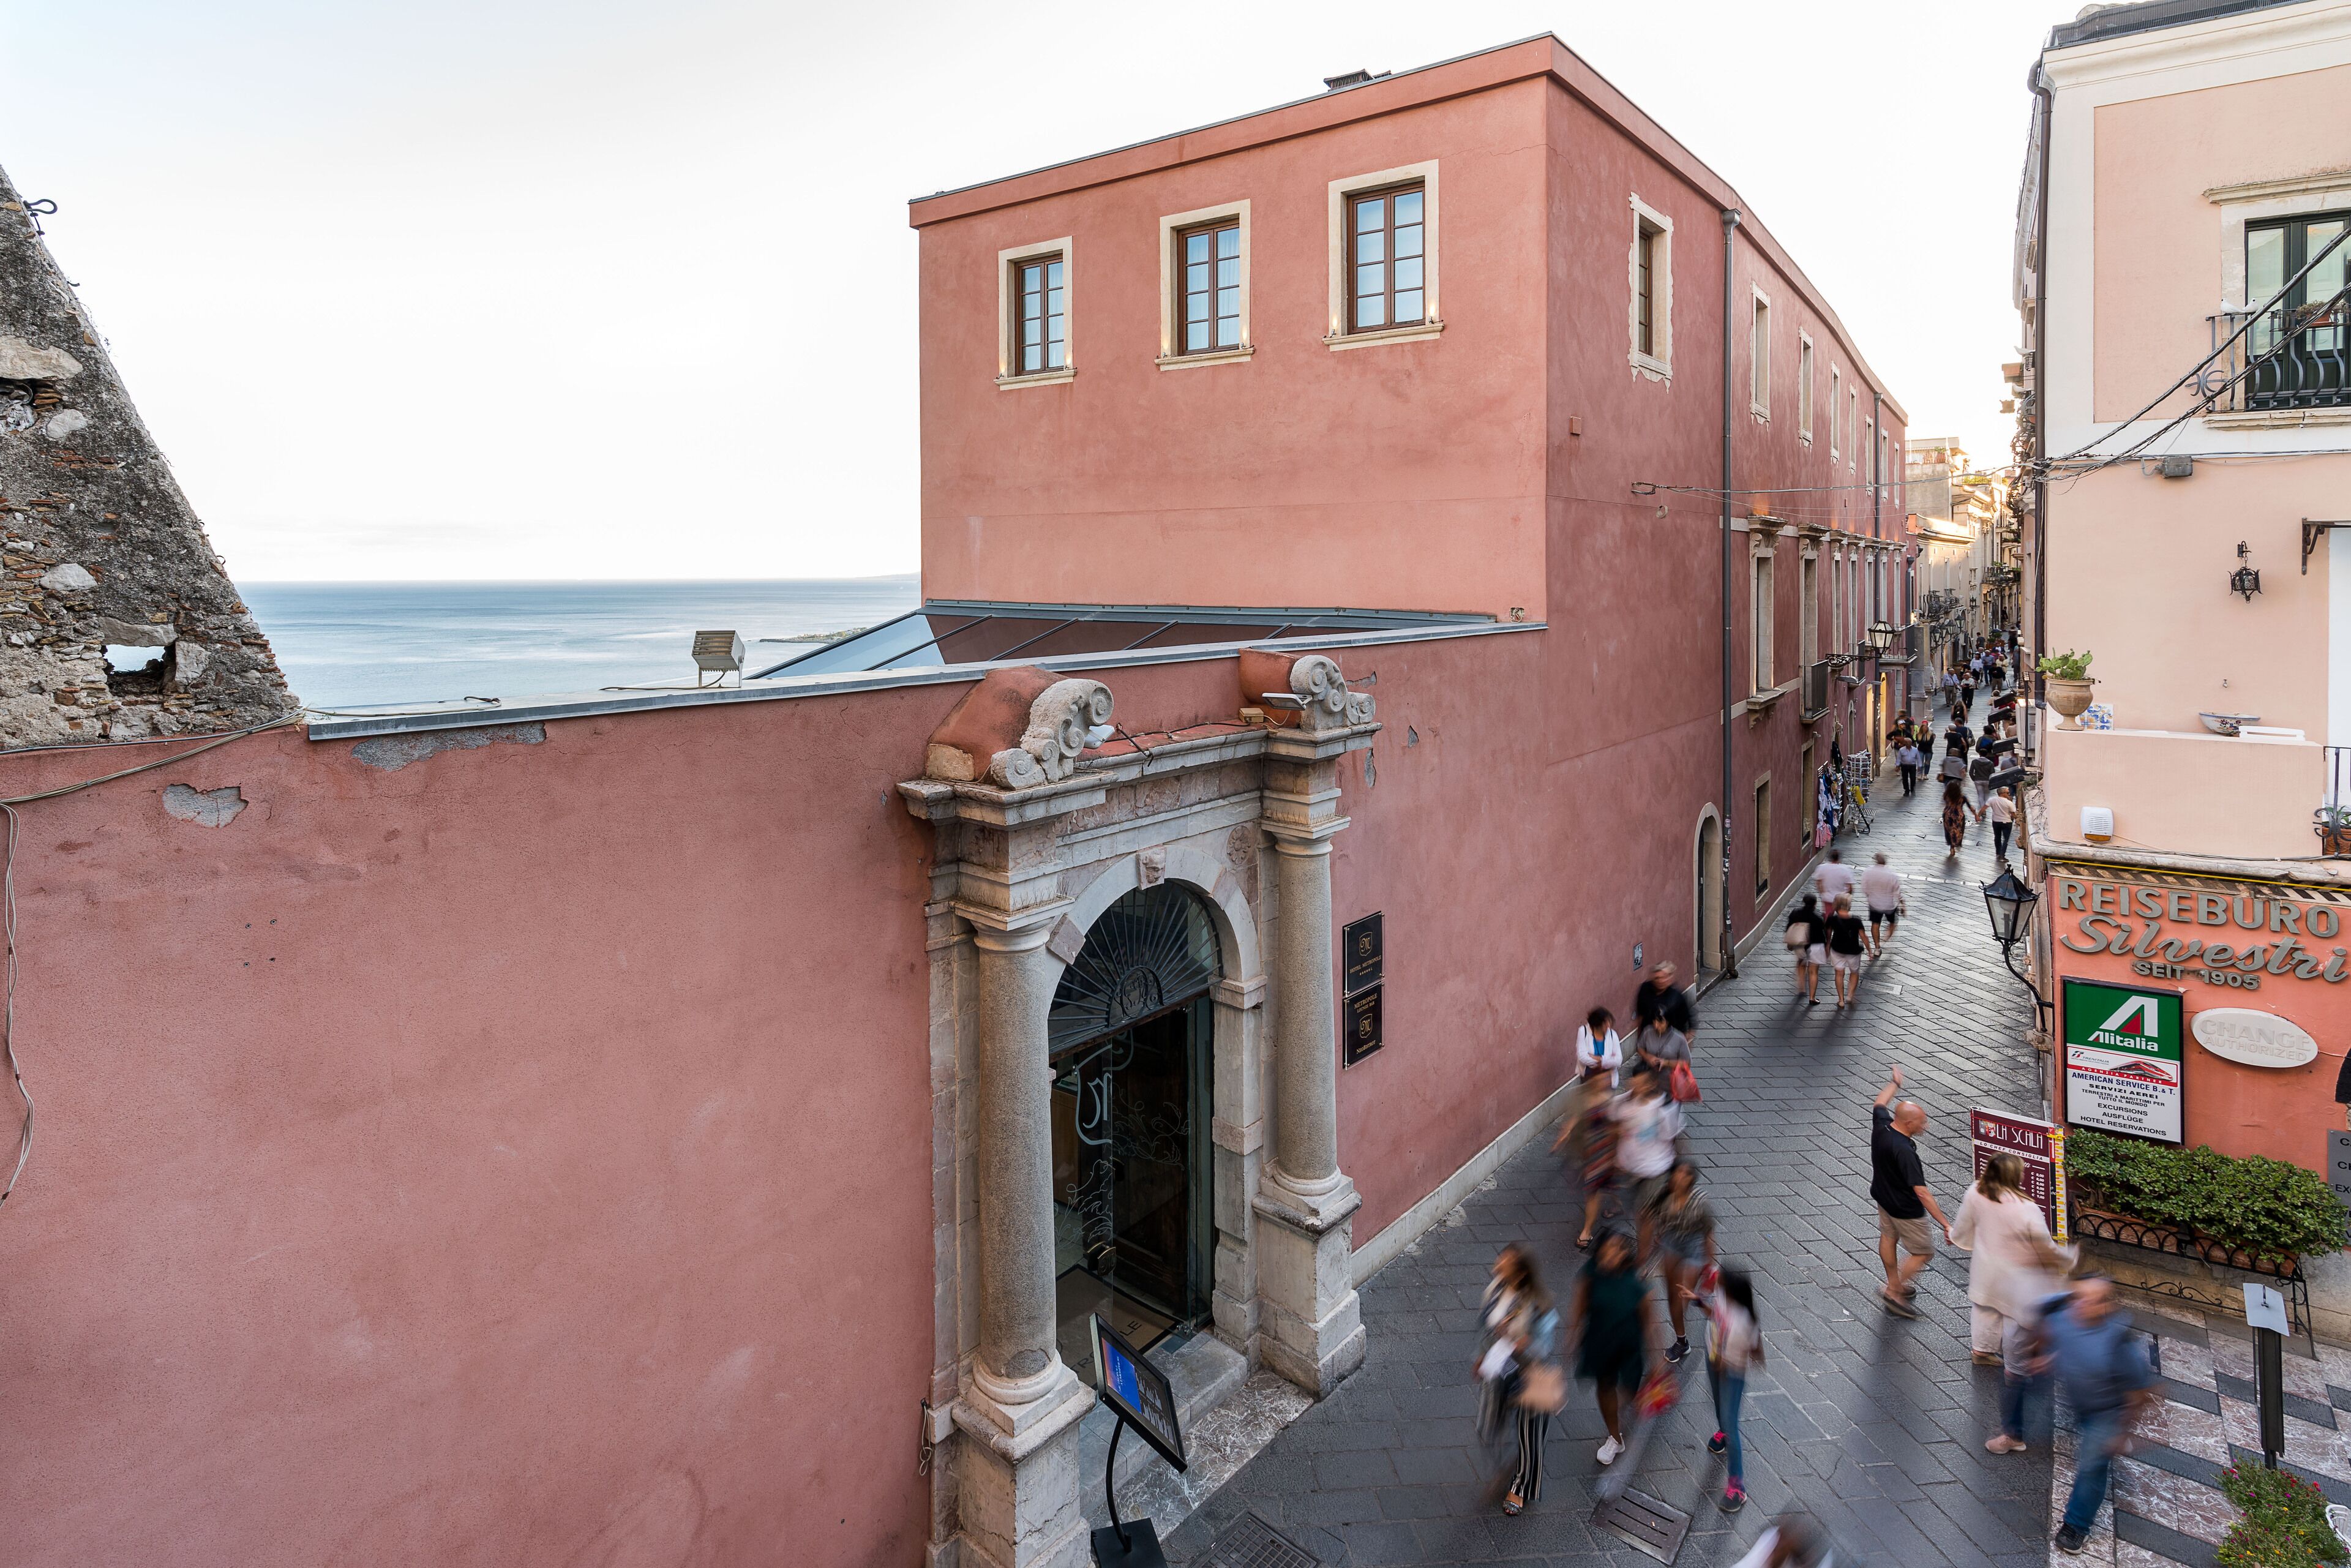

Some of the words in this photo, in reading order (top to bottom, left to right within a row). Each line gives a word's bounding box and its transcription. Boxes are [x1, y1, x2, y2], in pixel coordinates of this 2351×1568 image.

[2060, 880, 2339, 937] REISEBURO
[2059, 915, 2349, 982] Silvestri
[1349, 965, 1362, 973] HOTEL
[1362, 955, 1382, 967] METROPOLE
[2135, 960, 2184, 980] SEIT
[2199, 969, 2260, 989] 1905
[1354, 993, 1378, 1009] METROPOLE
[1357, 1004, 1369, 1013] LOUNGE
[2087, 1031, 2158, 1051] Alitalia
[2200, 1019, 2311, 1051] CHANGE
[2203, 1035, 2307, 1061] AUTHORIZED
[2072, 1072, 2113, 1084] AMERICAN
[2116, 1079, 2150, 1090] SERVICE
[2082, 1067, 2119, 1076] AGENZIA
[2124, 1074, 2162, 1084] PARTNER
[2082, 1089, 2113, 1098] TERRESTRI
[2120, 1095, 2151, 1104] MARITTIMI
[2089, 1084, 2126, 1093] SERVIZI
[2098, 1103, 2148, 1116] EXCURSIONS
[2102, 1112, 2143, 1123] AUSFLÜGE
[2080, 1116, 2105, 1125] HOTEL
[2108, 1121, 2167, 1136] RESERVATIONS
[1997, 1123, 2007, 1141] LA
[2012, 1127, 2042, 1149] SCALA
[2009, 1149, 2043, 1161] CONSIGLIA
